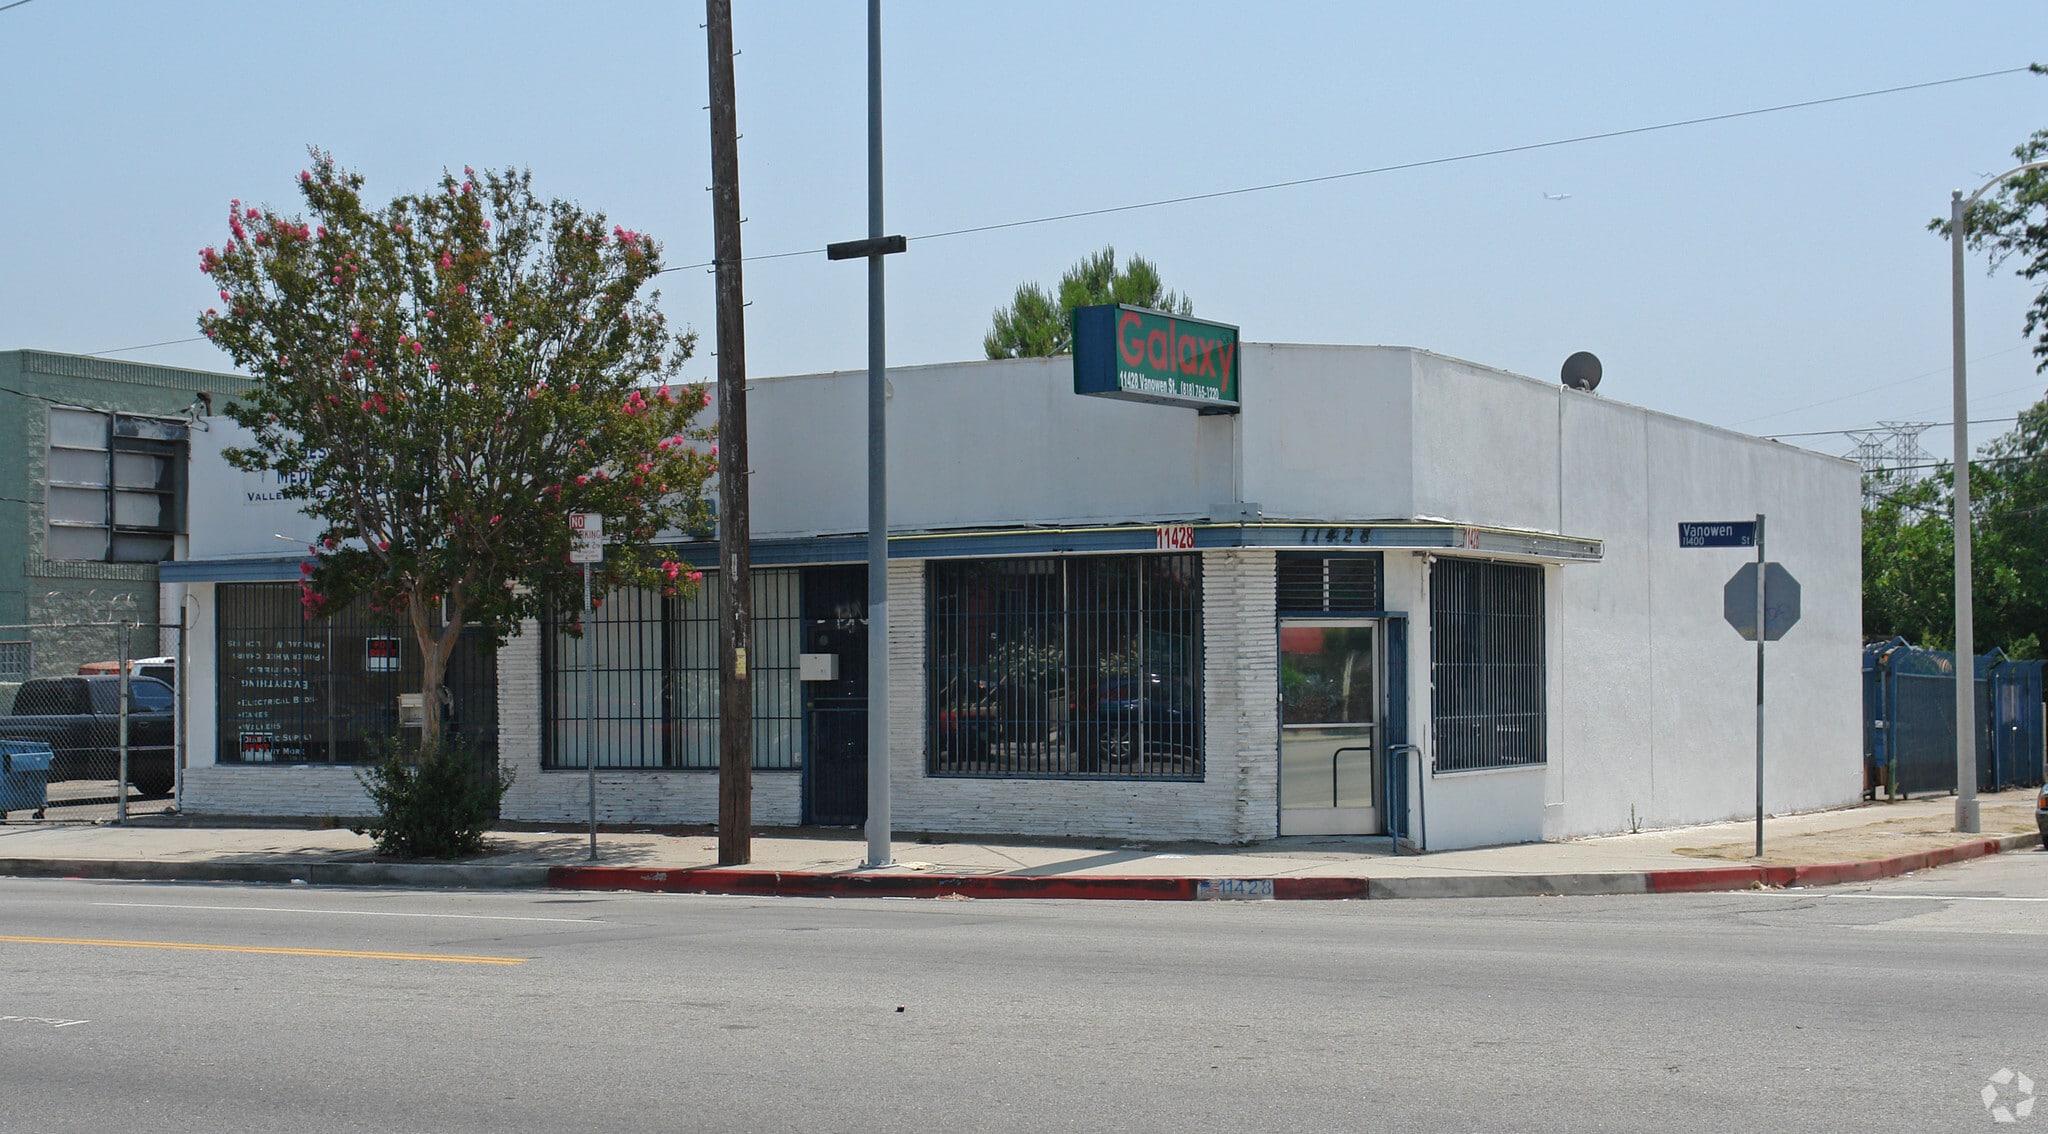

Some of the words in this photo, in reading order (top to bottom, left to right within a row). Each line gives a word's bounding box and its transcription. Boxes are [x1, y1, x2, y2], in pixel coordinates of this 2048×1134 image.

[1118, 311, 1235, 392] Galaxy
[1120, 370, 1138, 388] 11428
[1139, 373, 1167, 392] Vanowen
[1168, 378, 1177, 394] St.
[571, 516, 584, 528] NO
[1157, 526, 1194, 549] 11428
[1301, 527, 1371, 543] 11428
[1683, 524, 1733, 536] Vanowen
[1682, 536, 1705, 546] 11400
[1741, 535, 1750, 545] St
[1218, 880, 1272, 895] 11428
